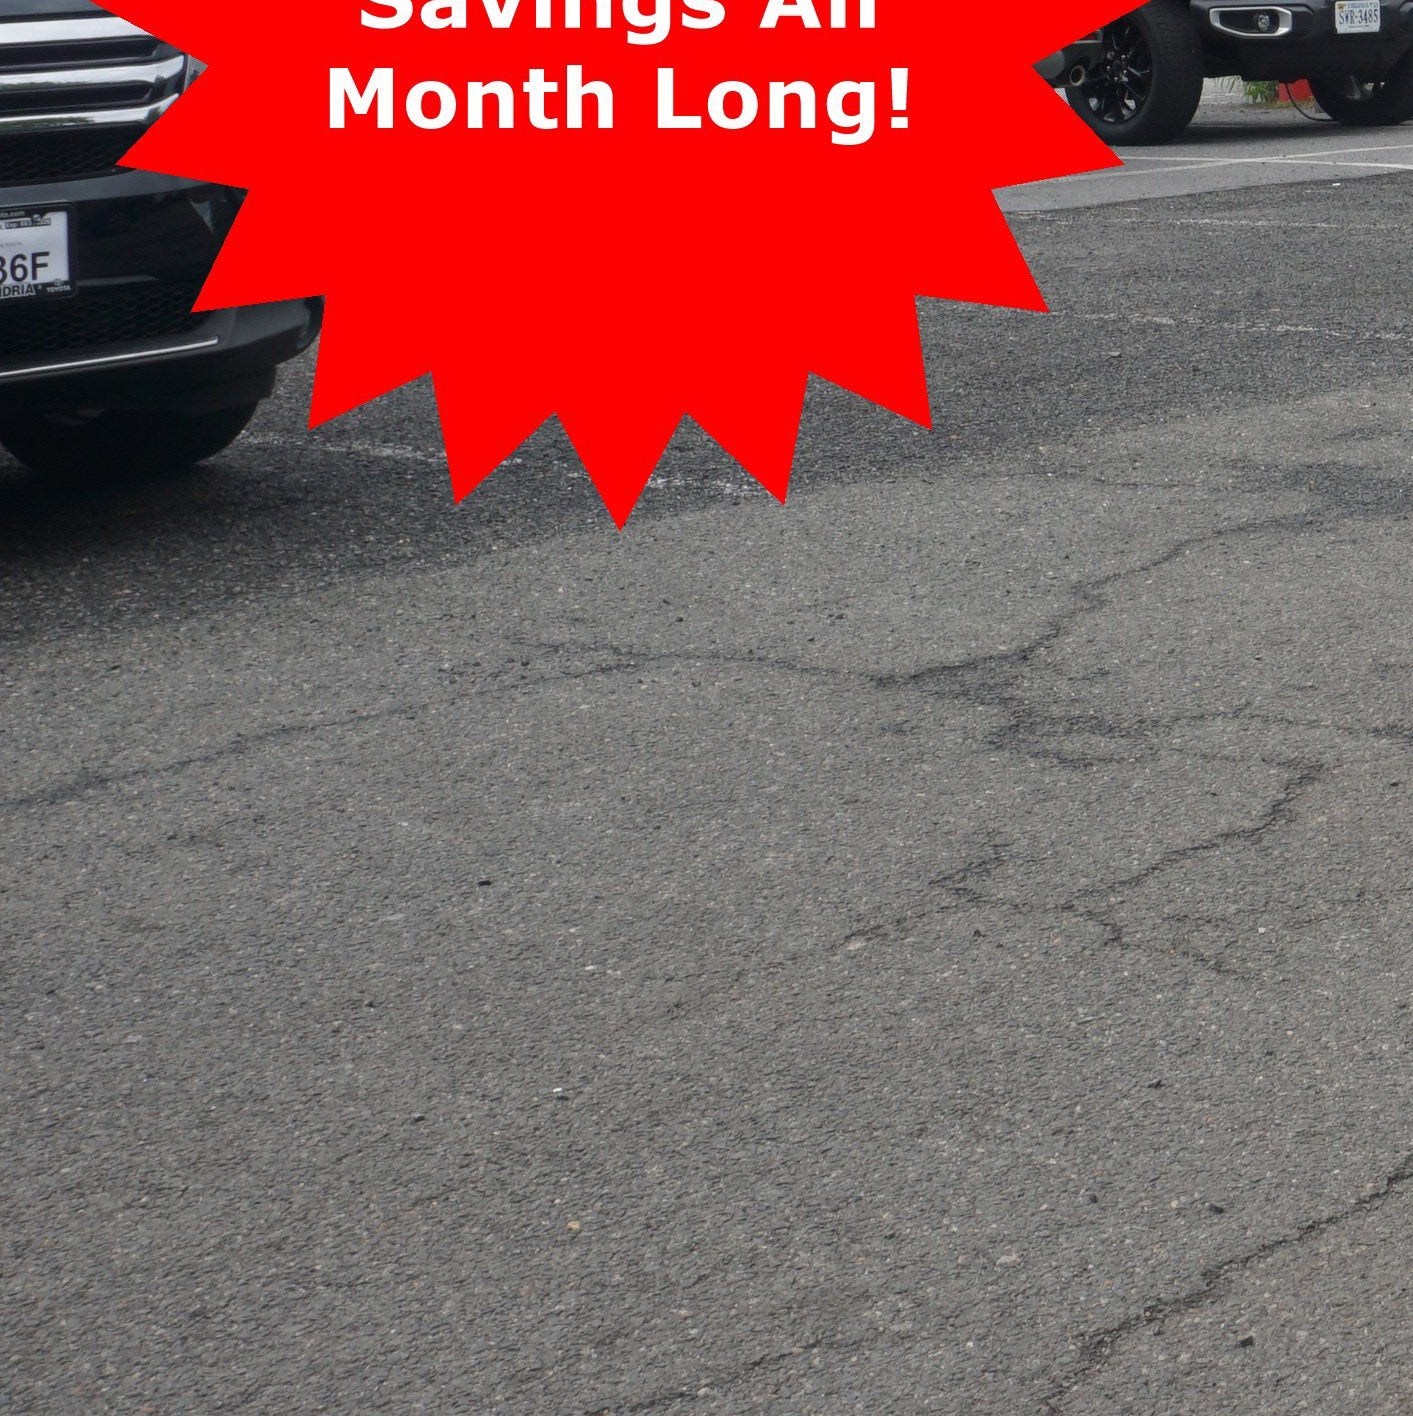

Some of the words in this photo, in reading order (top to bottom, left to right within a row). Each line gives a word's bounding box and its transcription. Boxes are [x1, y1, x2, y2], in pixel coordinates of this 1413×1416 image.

[1339, 9, 1379, 24] SWR-3485
[0, 284, 36, 298] DRIA
[47, 285, 71, 293] TOYOTA
